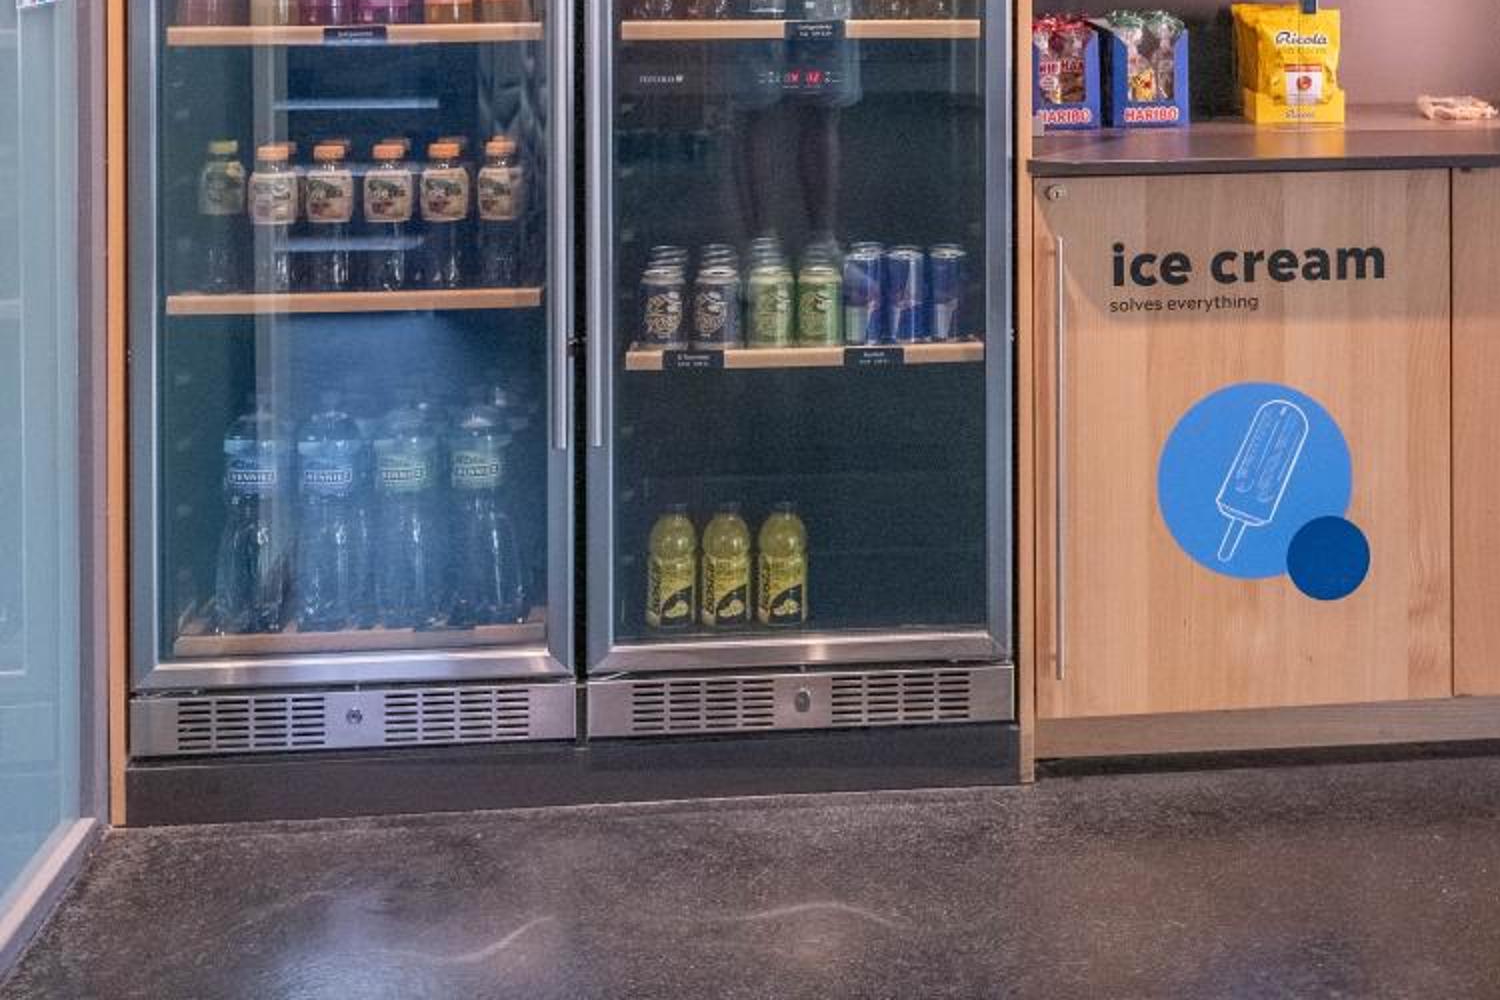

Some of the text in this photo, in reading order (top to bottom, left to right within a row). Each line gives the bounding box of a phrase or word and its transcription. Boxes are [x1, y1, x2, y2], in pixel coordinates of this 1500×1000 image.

[1275, 30, 1328, 45] Ricola
[1125, 107, 1179, 121] HARIBO
[1112, 242, 1386, 287] ice cream
[1109, 294, 1260, 313] solves everything
